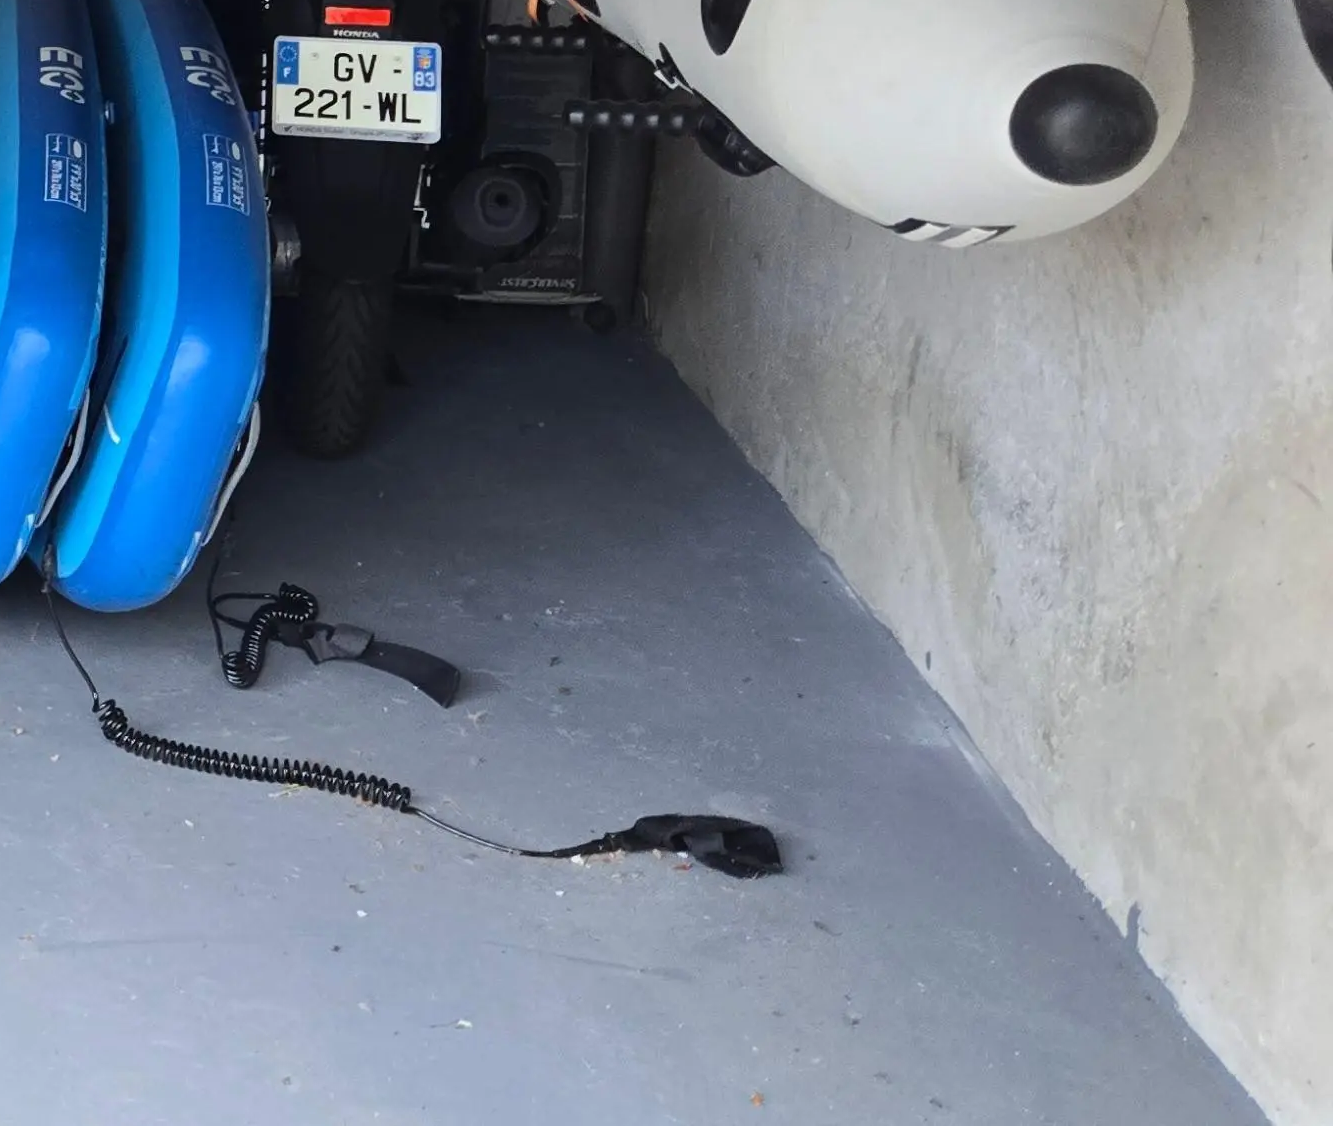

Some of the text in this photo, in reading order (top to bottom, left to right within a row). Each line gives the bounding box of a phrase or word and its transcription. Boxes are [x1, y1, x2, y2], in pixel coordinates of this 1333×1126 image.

[332, 28, 380, 39] HONDA
[282, 66, 292, 79] F
[333, 52, 378, 84] GV
[414, 71, 436, 88] 83
